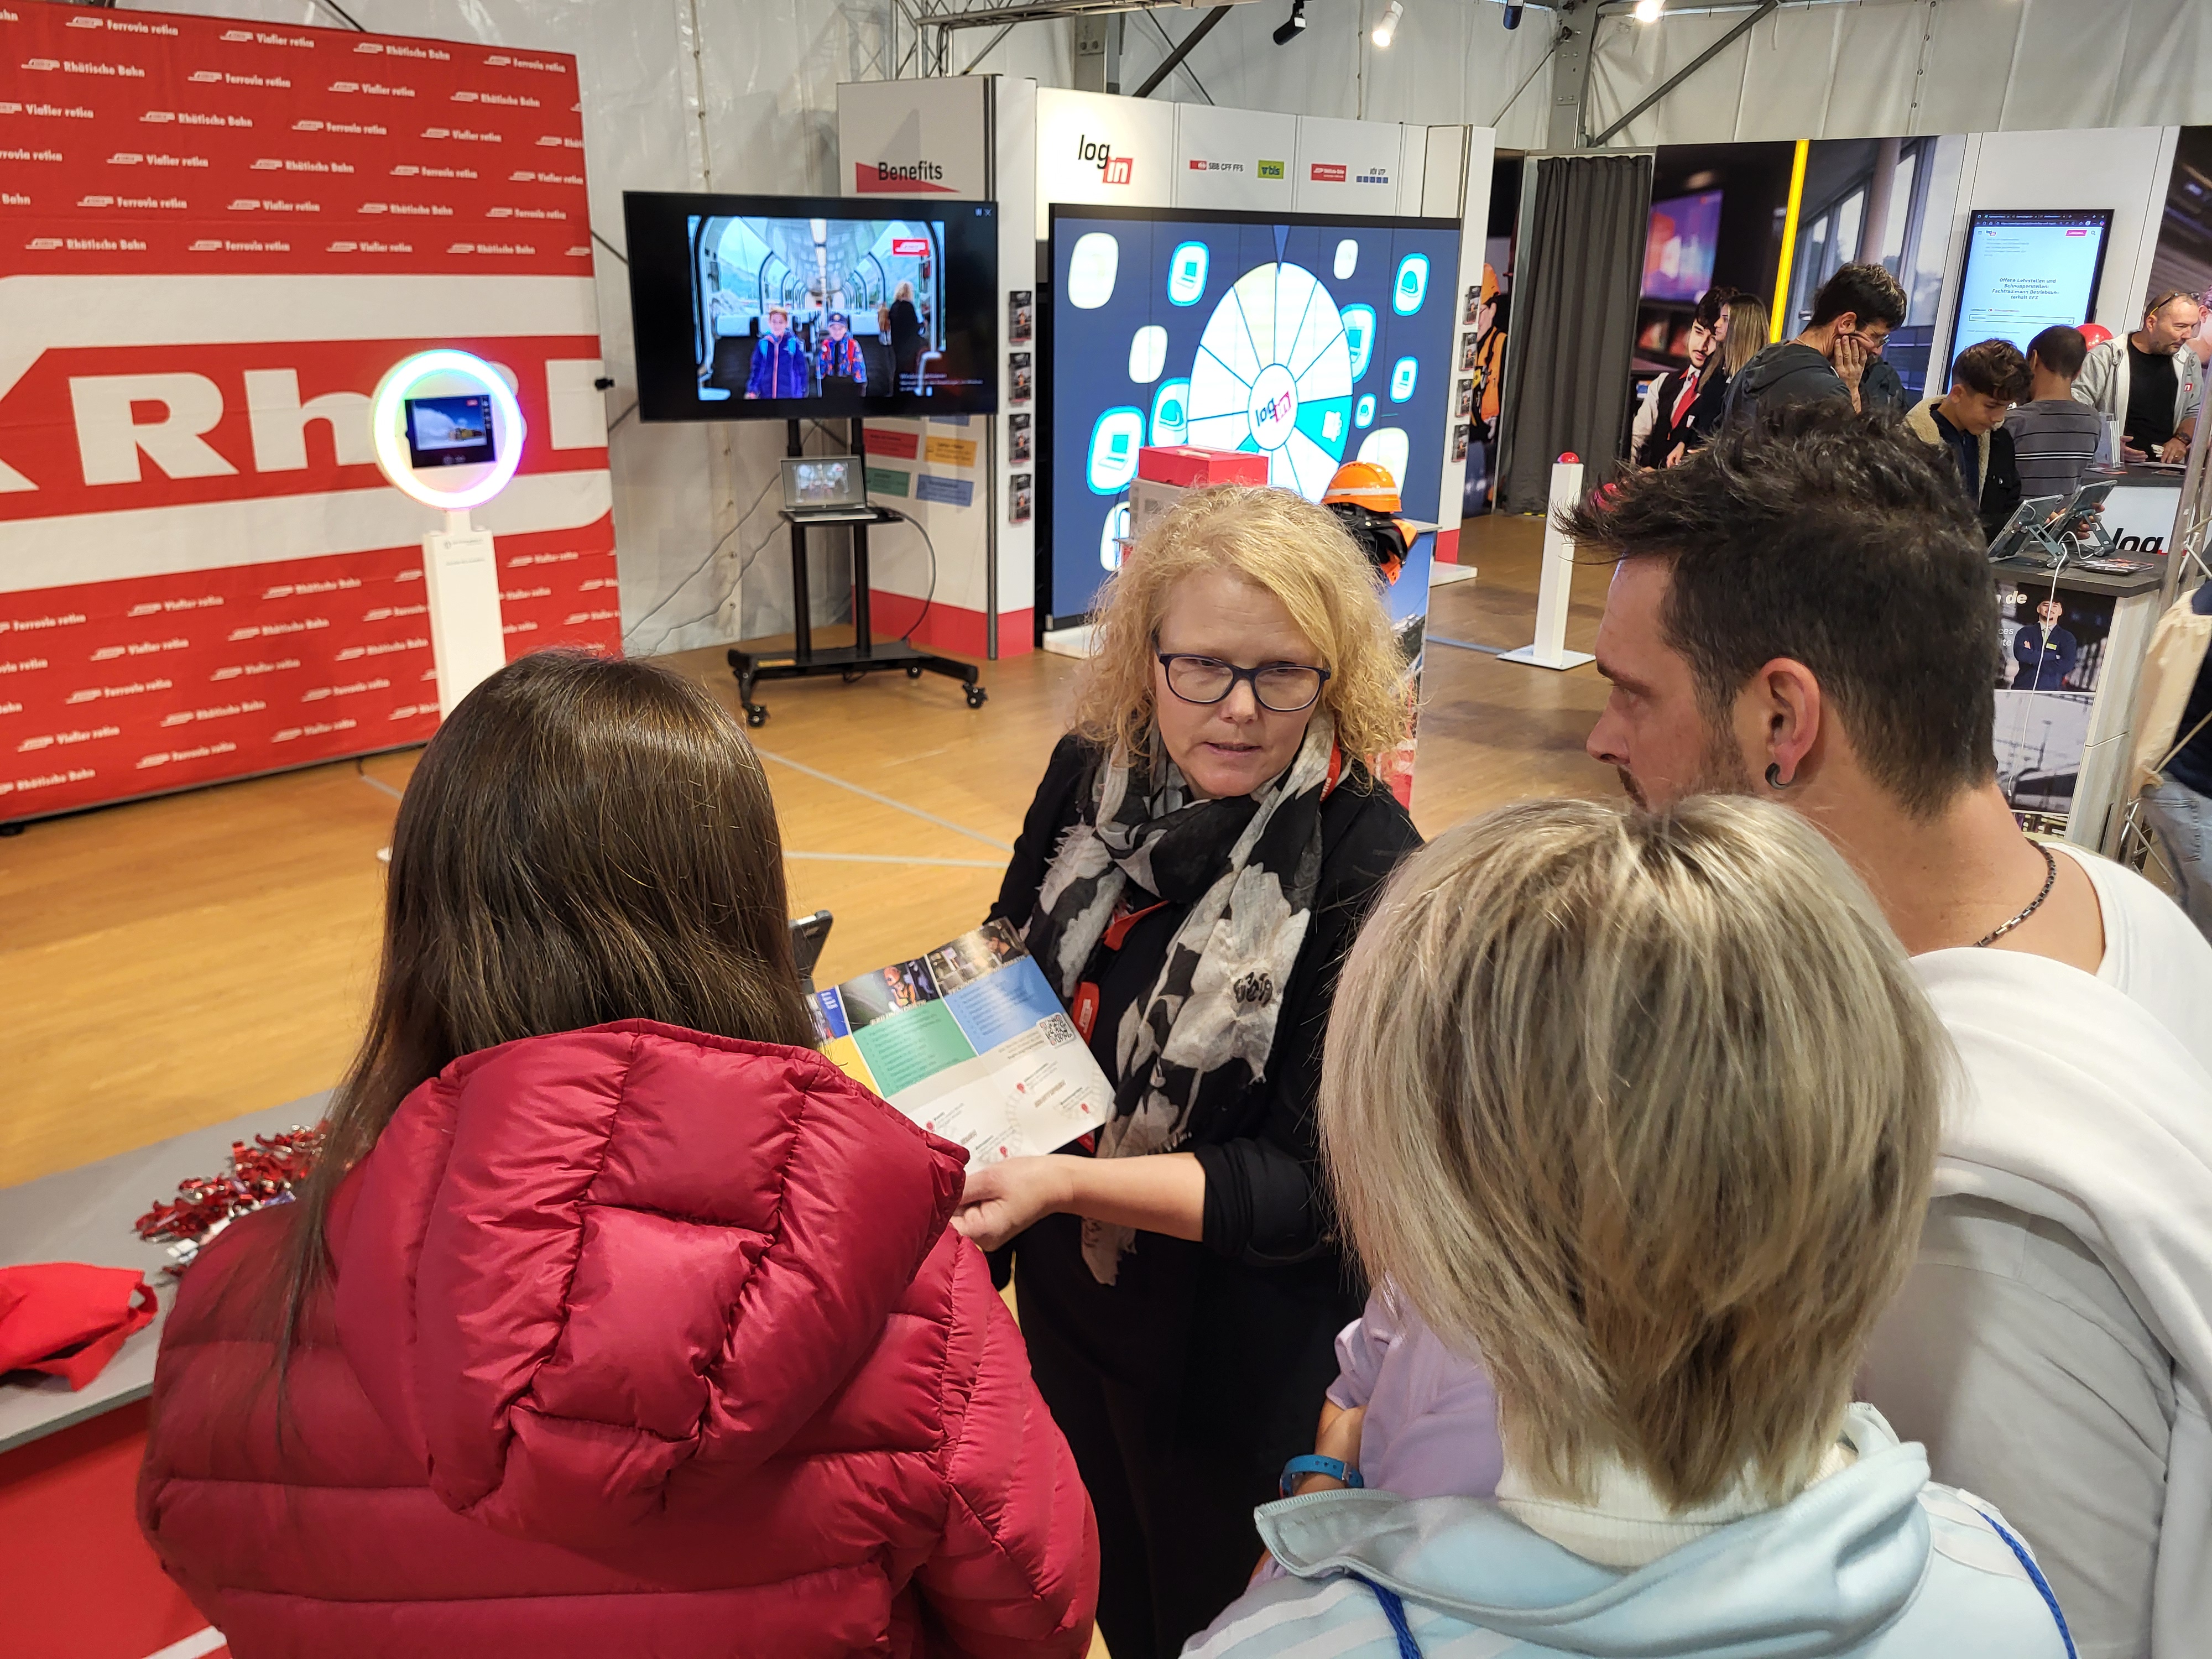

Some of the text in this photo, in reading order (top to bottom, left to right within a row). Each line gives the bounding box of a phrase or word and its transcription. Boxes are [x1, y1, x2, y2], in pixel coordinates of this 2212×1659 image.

[0, 8, 18, 22] ahn
[107, 19, 179, 36] Ferrovia retica
[256, 33, 315, 48] Viafier retica
[385, 45, 451, 60] Rhätische Bahn
[63, 60, 145, 77] Rhätische Bahn
[225, 72, 291, 88] Ferrovia retica
[361, 84, 415, 97] Viafier retica
[25, 103, 94, 118] Viafier retica
[178, 112, 253, 127] Rhätische Bahn
[326, 122, 387, 135] Ferrovia retica
[33, 150, 62, 161] retica
[1078, 135, 1110, 169] log
[146, 154, 208, 167] Viafier retica
[285, 160, 354, 173] Rhätische Bahn
[879, 160, 943, 180] Benefits
[1, 193, 31, 205] Bahn
[117, 196, 187, 208] Ferrovia retica
[262, 200, 320, 212] Viafier retica
[66, 238, 147, 251] Rhätische Bahn
[225, 241, 290, 252] Ferrovia retica
[69, 361, 526, 486] Rh
[2005, 591, 2027, 604] de
[0, 702, 23, 714] ahn
